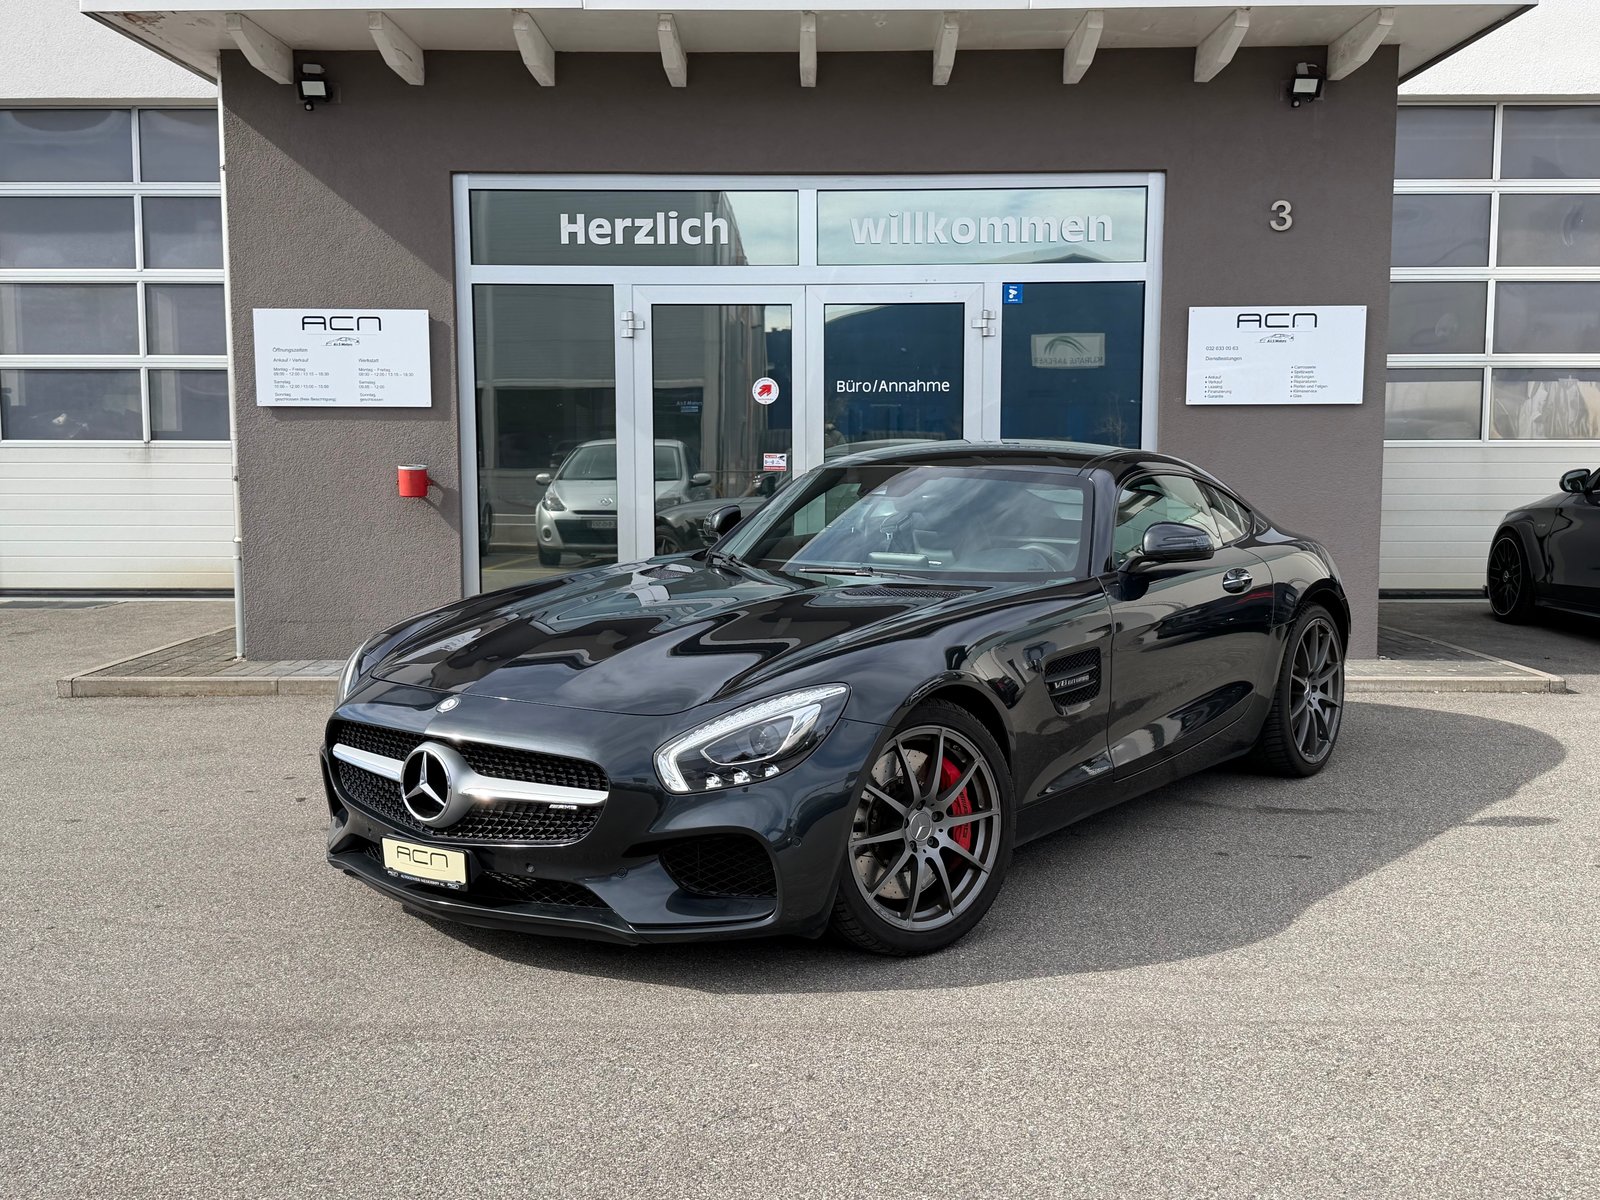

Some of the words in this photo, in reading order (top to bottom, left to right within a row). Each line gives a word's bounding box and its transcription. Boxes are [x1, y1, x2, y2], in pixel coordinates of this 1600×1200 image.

[1270, 200, 1293, 231] 3
[559, 210, 730, 246] Herzlich
[849, 209, 1113, 245] willkommen
[301, 315, 382, 332] ACN
[1236, 312, 1318, 329] ACN
[836, 379, 951, 393] Büro/Annahme
